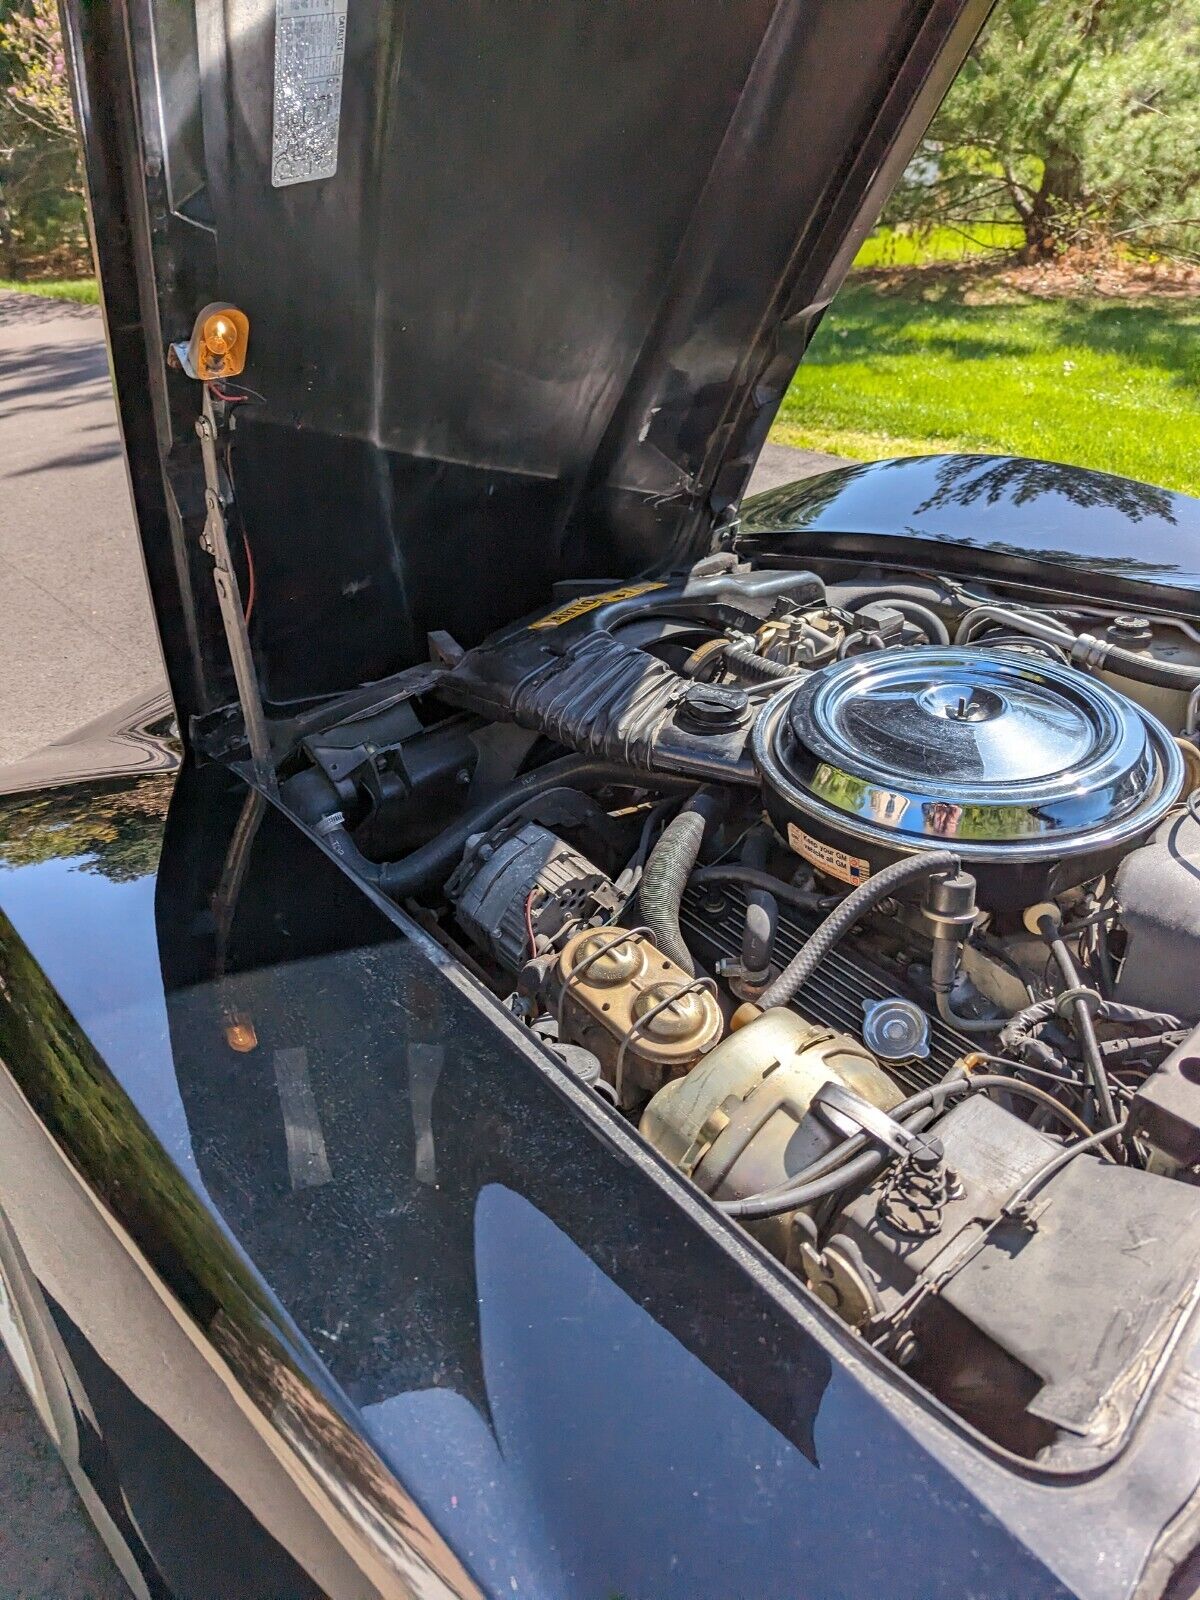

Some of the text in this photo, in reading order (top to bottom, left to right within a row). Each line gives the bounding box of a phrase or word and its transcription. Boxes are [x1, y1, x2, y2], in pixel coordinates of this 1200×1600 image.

[336, 15, 346, 51] CATALYST
[803, 833, 818, 848] Keep
[819, 845, 834, 855] your
[835, 852, 847, 861] GM
[804, 844, 825, 859] vehicle
[835, 860, 847, 869] GM
